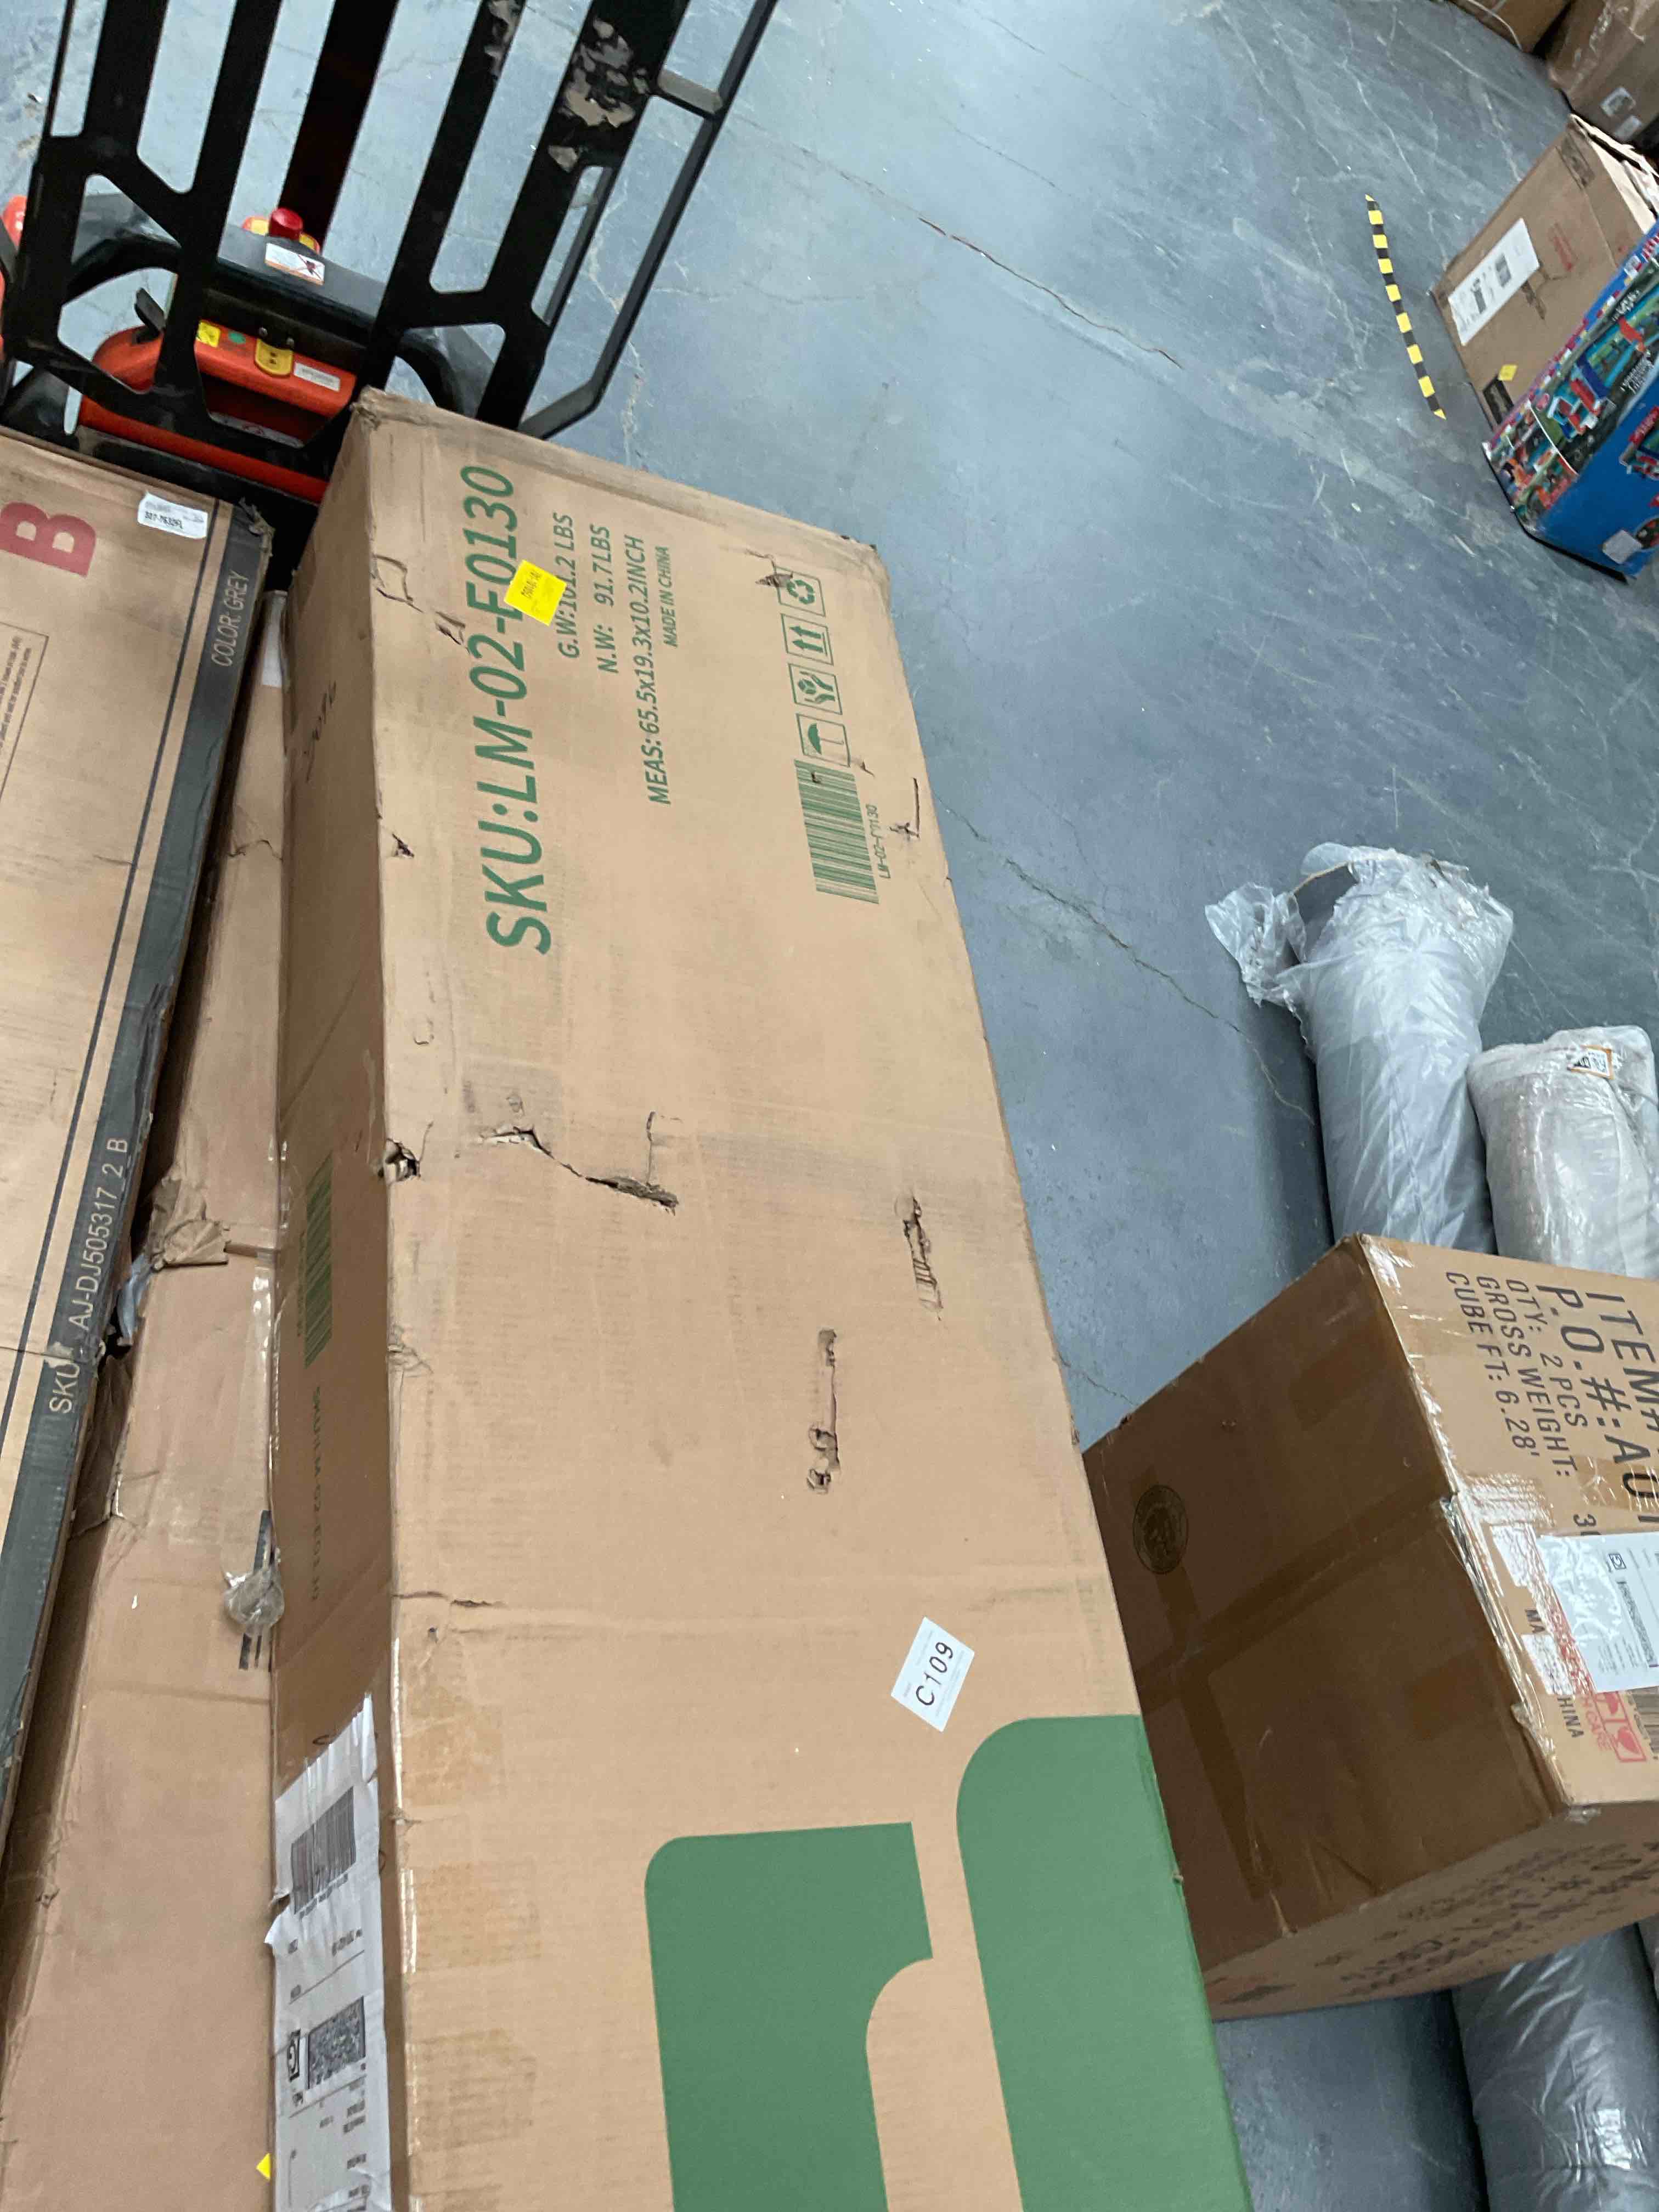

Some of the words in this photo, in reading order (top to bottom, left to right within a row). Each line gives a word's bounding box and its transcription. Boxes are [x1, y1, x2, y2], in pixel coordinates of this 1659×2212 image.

[0, 501, 96, 577] B
[552, 512, 575, 551] LBS
[655, 546, 673, 588] CHINA
[224, 571, 250, 611] GREY
[660, 590, 675, 606] IN
[661, 608, 678, 648] MADE
[460, 465, 551, 955] SKU:LM-02-F0130
[1446, 1271, 1494, 1335] CUBE
[1477, 1344, 1510, 1381] FT:
[1476, 1276, 1532, 1357] GROSS
[1517, 1368, 1578, 1477] WEIGHT:
[1539, 1352, 1563, 1369] 2
[1549, 1376, 1588, 1427] PCS
[916, 1641, 953, 1706] C109
[1557, 1696, 1584, 1738] HINA
